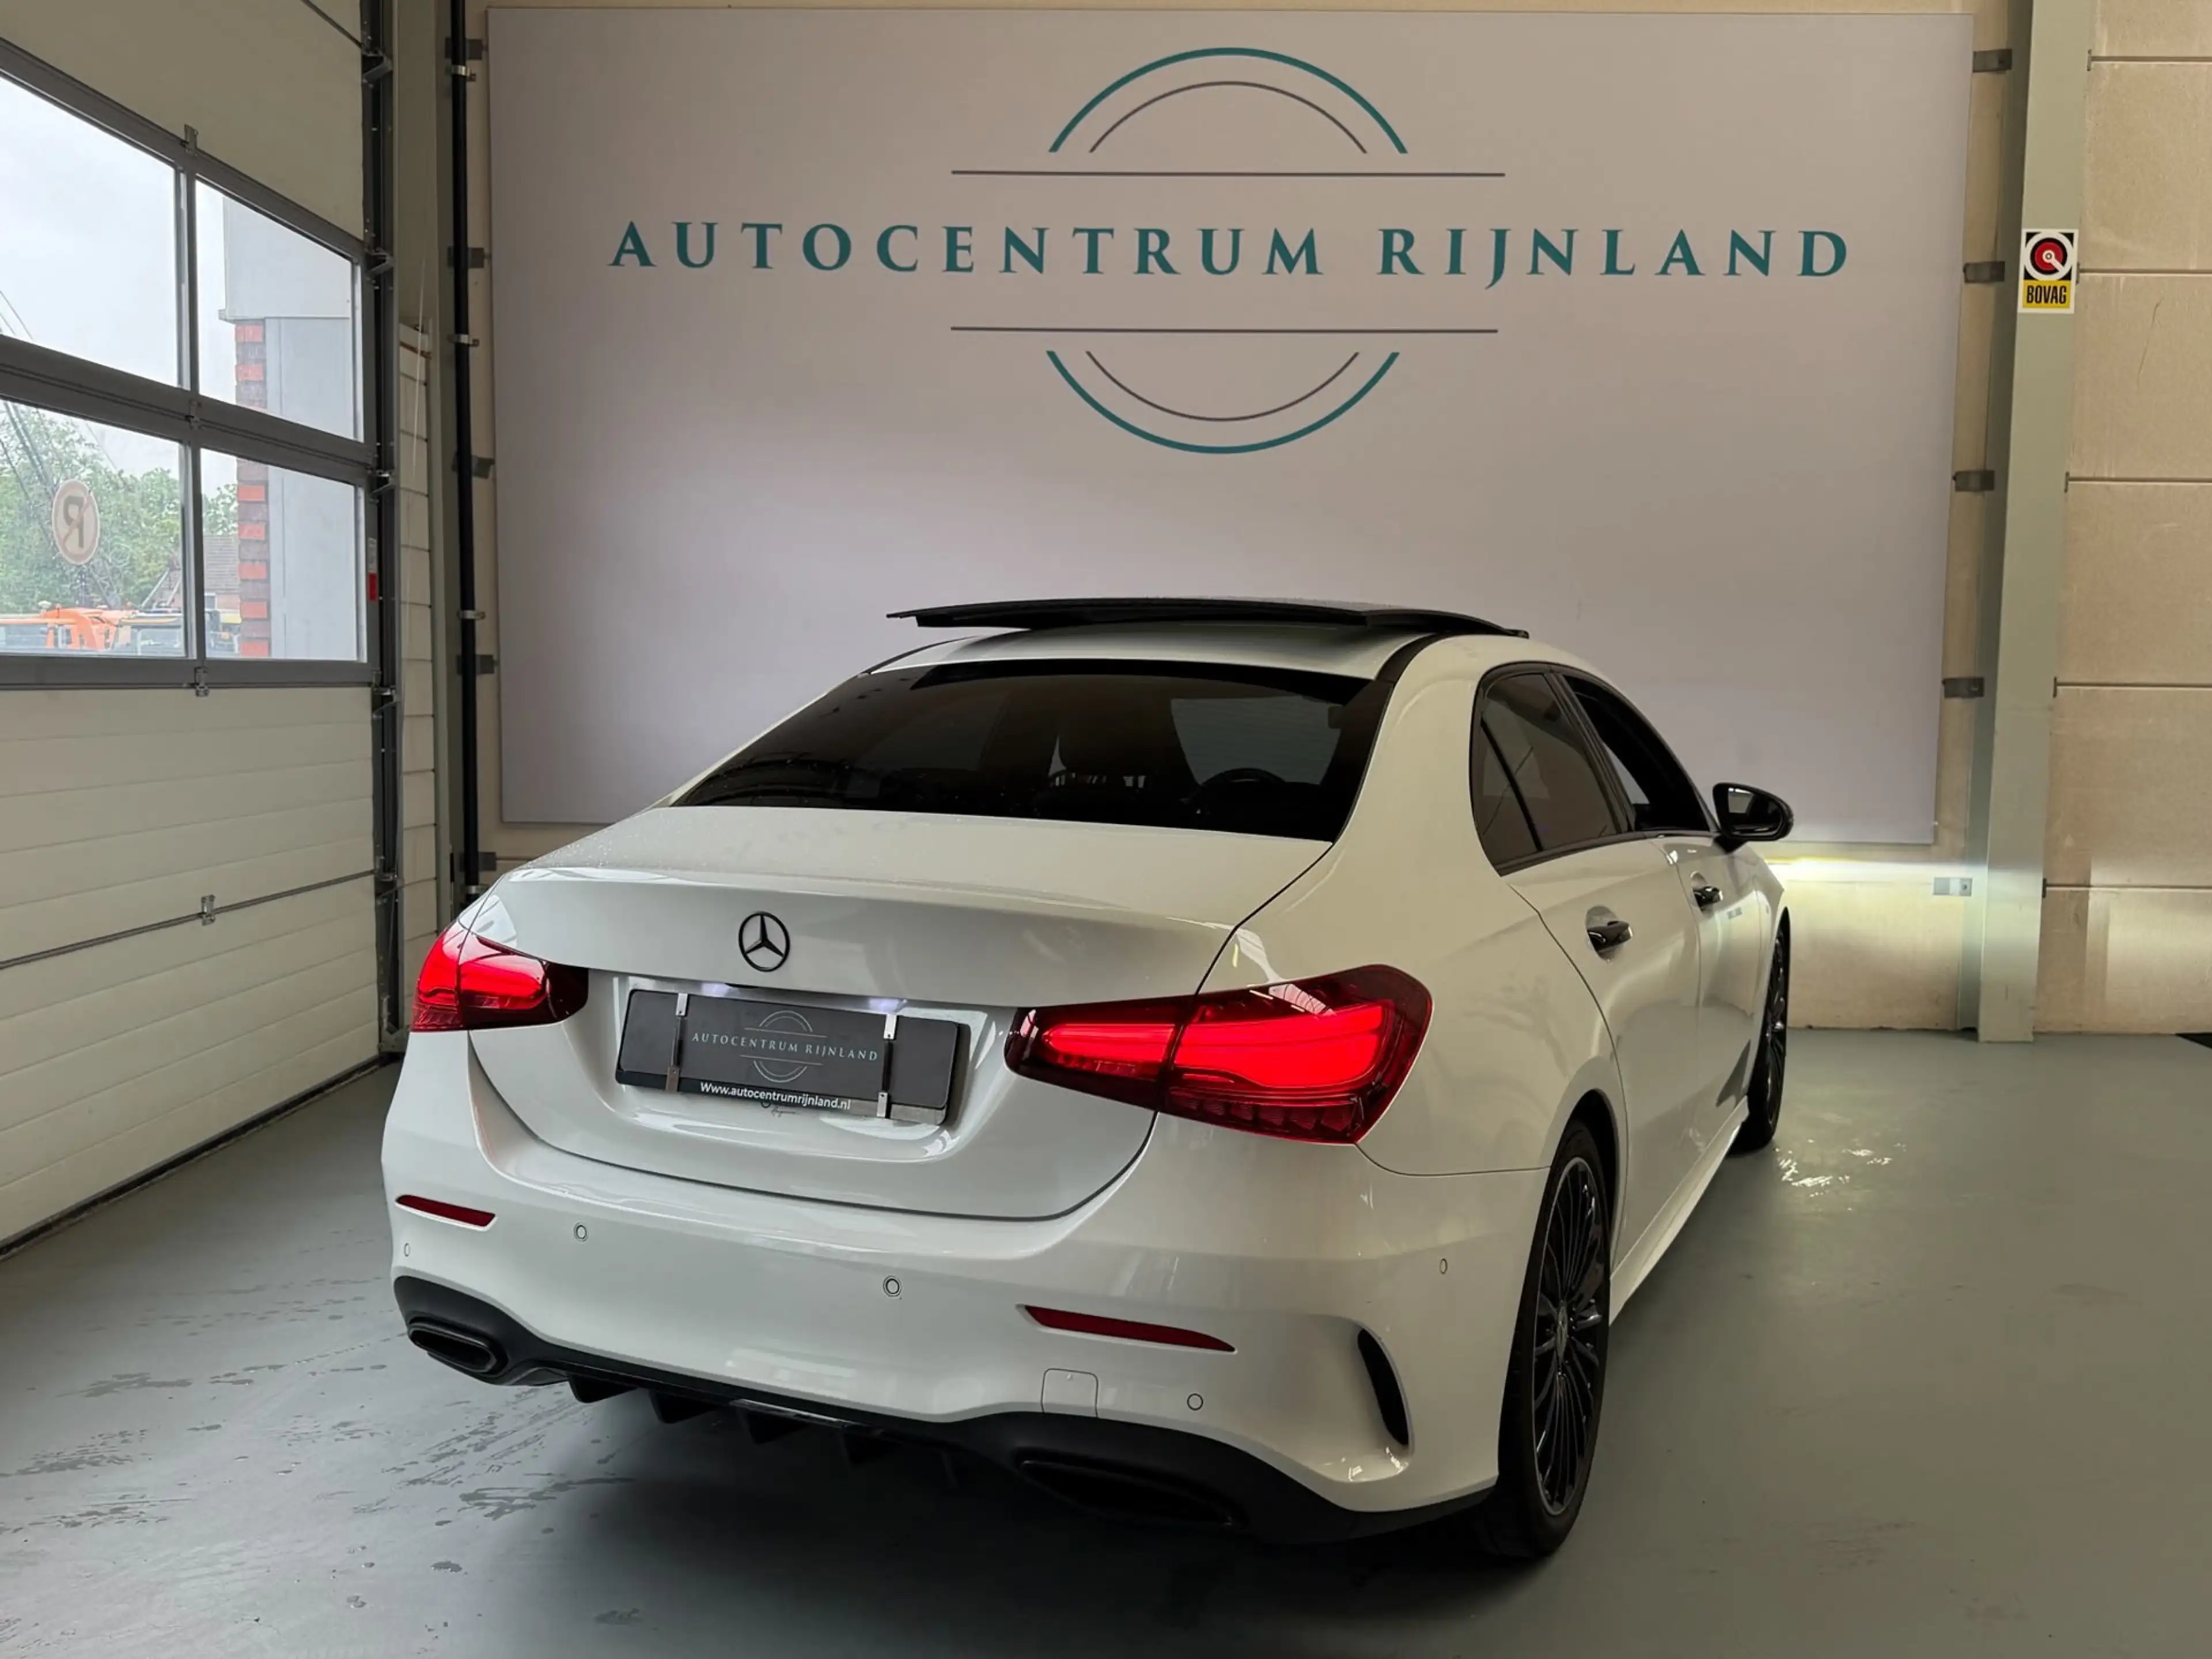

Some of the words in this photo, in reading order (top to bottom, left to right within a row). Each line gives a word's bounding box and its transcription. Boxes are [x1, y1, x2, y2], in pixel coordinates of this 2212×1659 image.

[608, 221, 1324, 275] AUTOCENTRUM
[1377, 228, 1847, 290] RIJNLAND
[2027, 285, 2067, 304] BOVAG
[692, 1032, 798, 1052] AUTOCENTRUM
[805, 1044, 878, 1062] RIJNLAND
